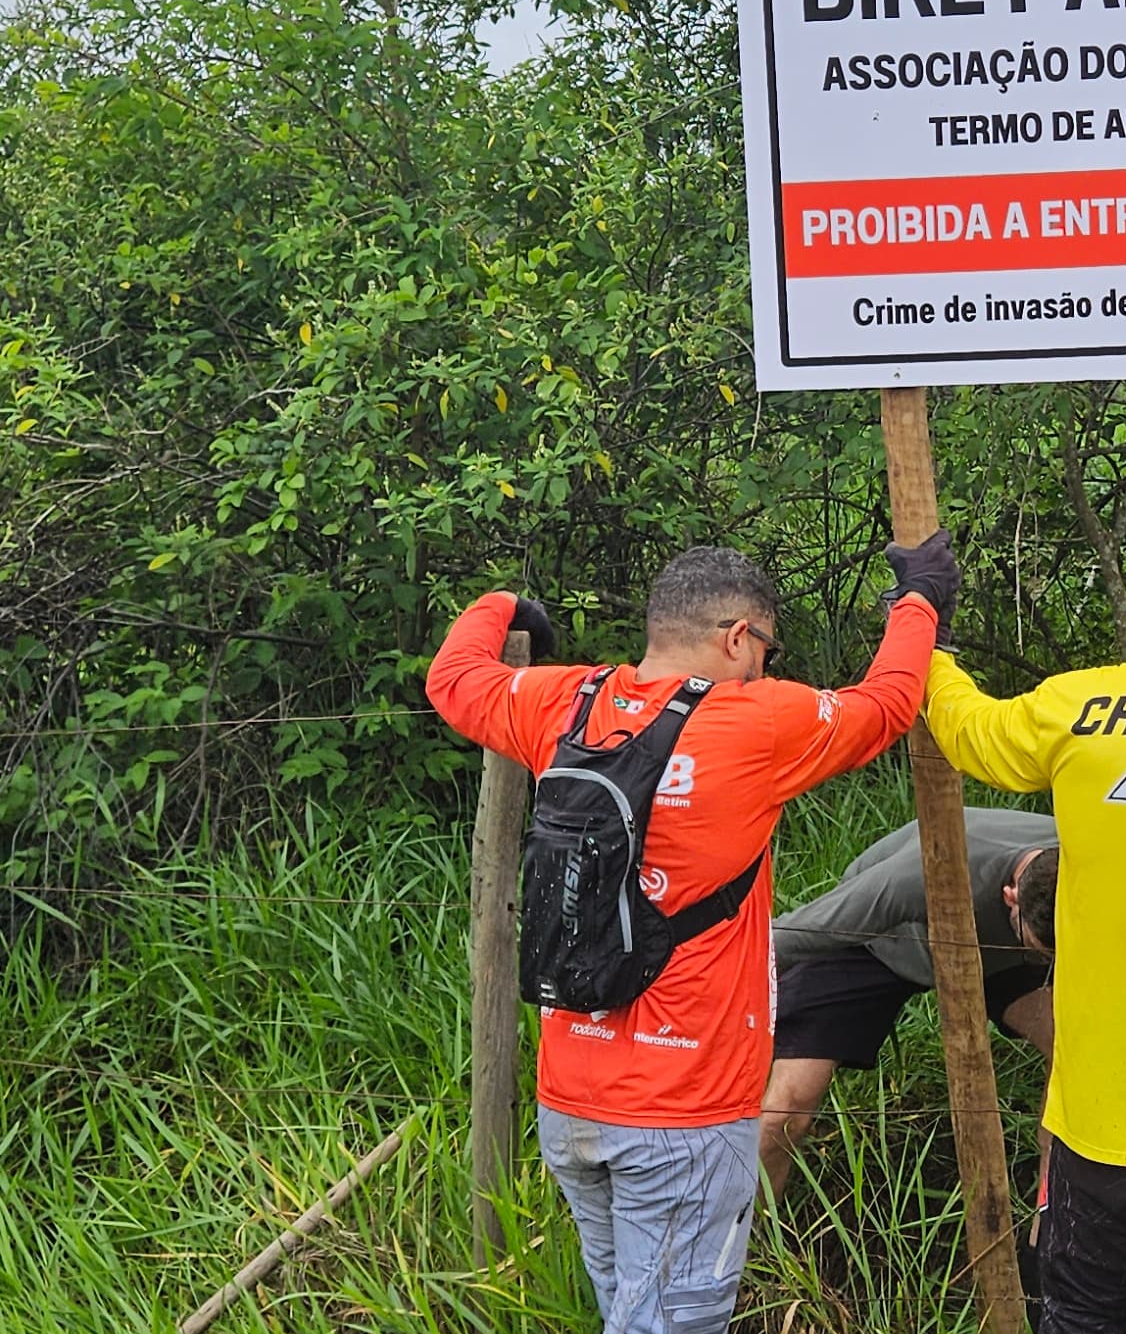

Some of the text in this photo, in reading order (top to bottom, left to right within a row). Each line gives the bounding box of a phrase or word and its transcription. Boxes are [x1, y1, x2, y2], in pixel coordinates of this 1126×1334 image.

[822, 40, 1069, 94] ASSOCIAÇÃO
[928, 112, 1043, 147] TERMO
[1052, 109, 1095, 142] DE
[802, 203, 992, 247] PROIBIDA
[1002, 201, 1030, 239] A
[853, 297, 935, 327] Crime
[944, 294, 977, 323] de
[985, 291, 1092, 321] invasão
